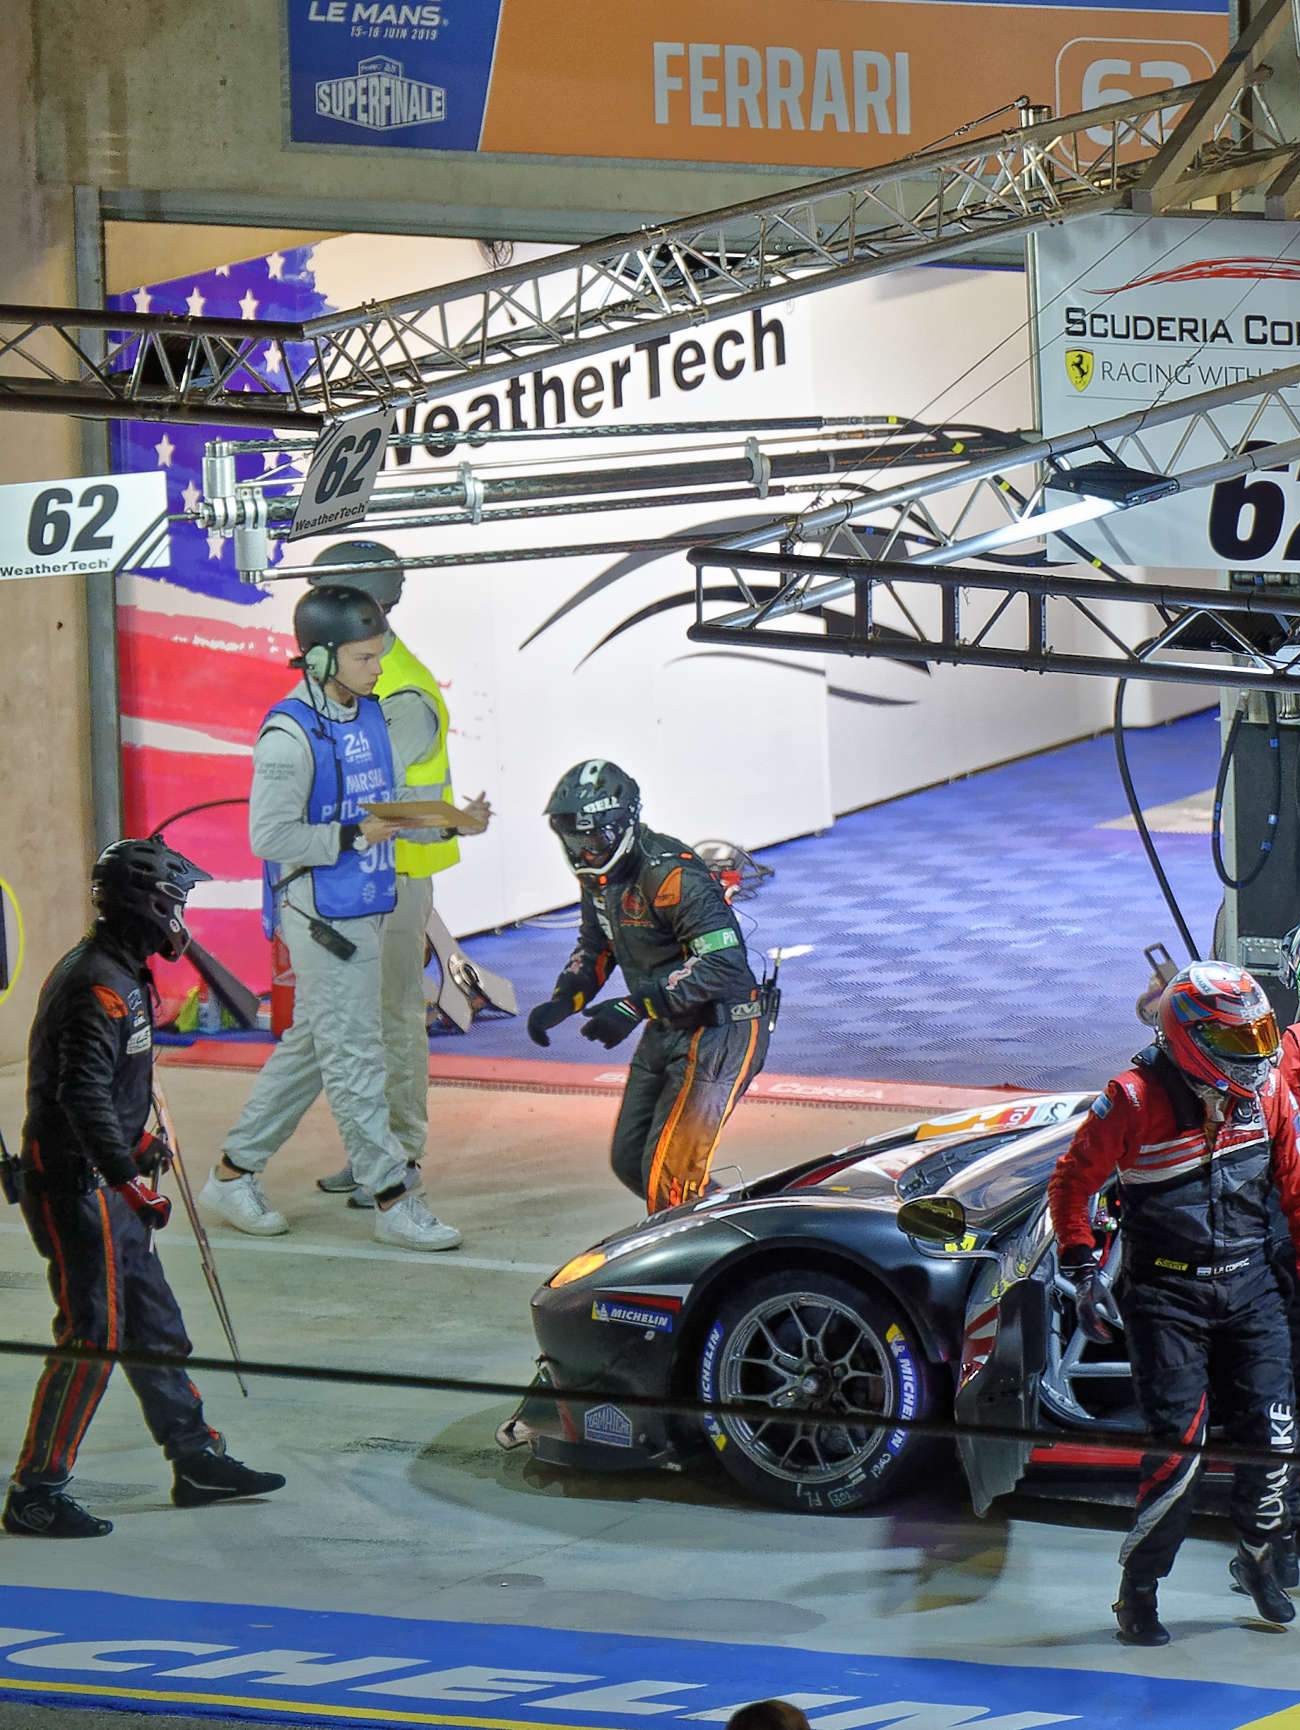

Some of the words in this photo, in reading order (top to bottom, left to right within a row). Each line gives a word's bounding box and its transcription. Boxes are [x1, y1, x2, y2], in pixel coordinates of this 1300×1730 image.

[308, 0, 348, 22] LE
[352, 3, 441, 26] MANS
[383, 27, 407, 39] JUIN
[411, 28, 438, 40] 2019
[317, 76, 443, 126] SUPERFINALE
[653, 42, 911, 135] FERRARI
[1101, 361, 1192, 385] RACING
[315, 428, 381, 504] 62
[28, 484, 119, 556] 62
[295, 503, 365, 532] WeatherTech
[0, 559, 108, 576] WeatherTech
[610, 1308, 669, 1327] MICHELIN
